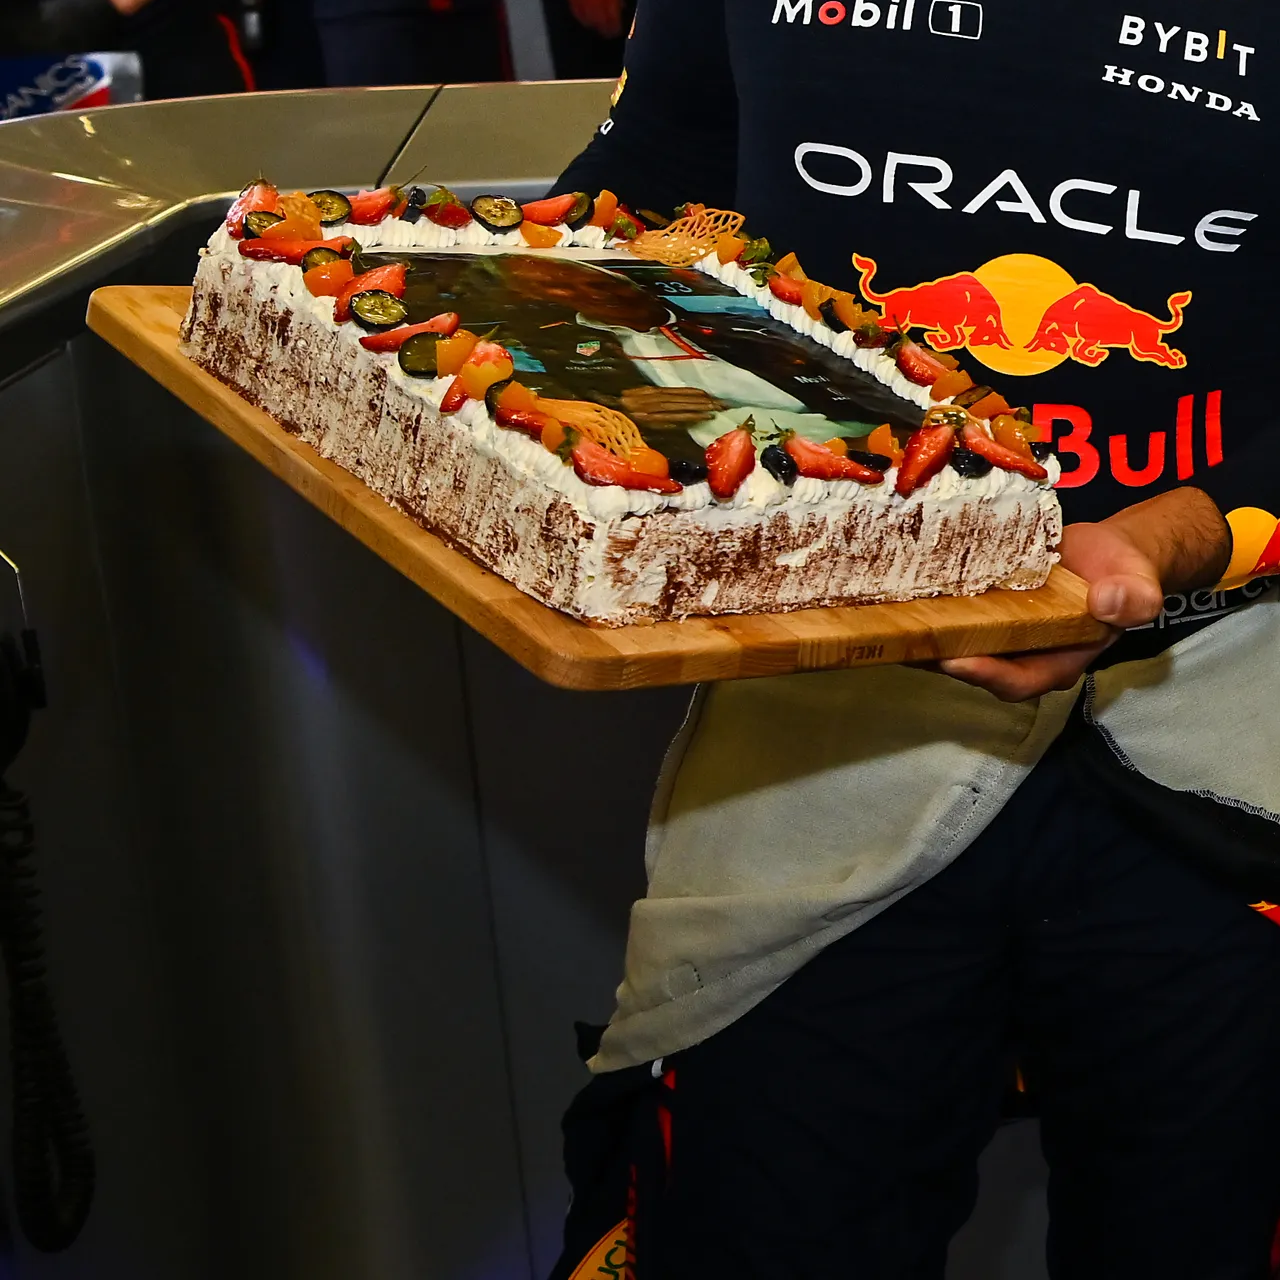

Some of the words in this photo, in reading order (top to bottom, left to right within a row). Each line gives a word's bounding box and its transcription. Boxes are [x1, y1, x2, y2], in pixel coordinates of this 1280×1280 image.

[947, 4, 962, 33] 1
[1119, 15, 1255, 77] BYBIT
[1102, 64, 1261, 121] HONDA
[794, 142, 1259, 252] ORACLE
[1032, 390, 1223, 488] Bull
